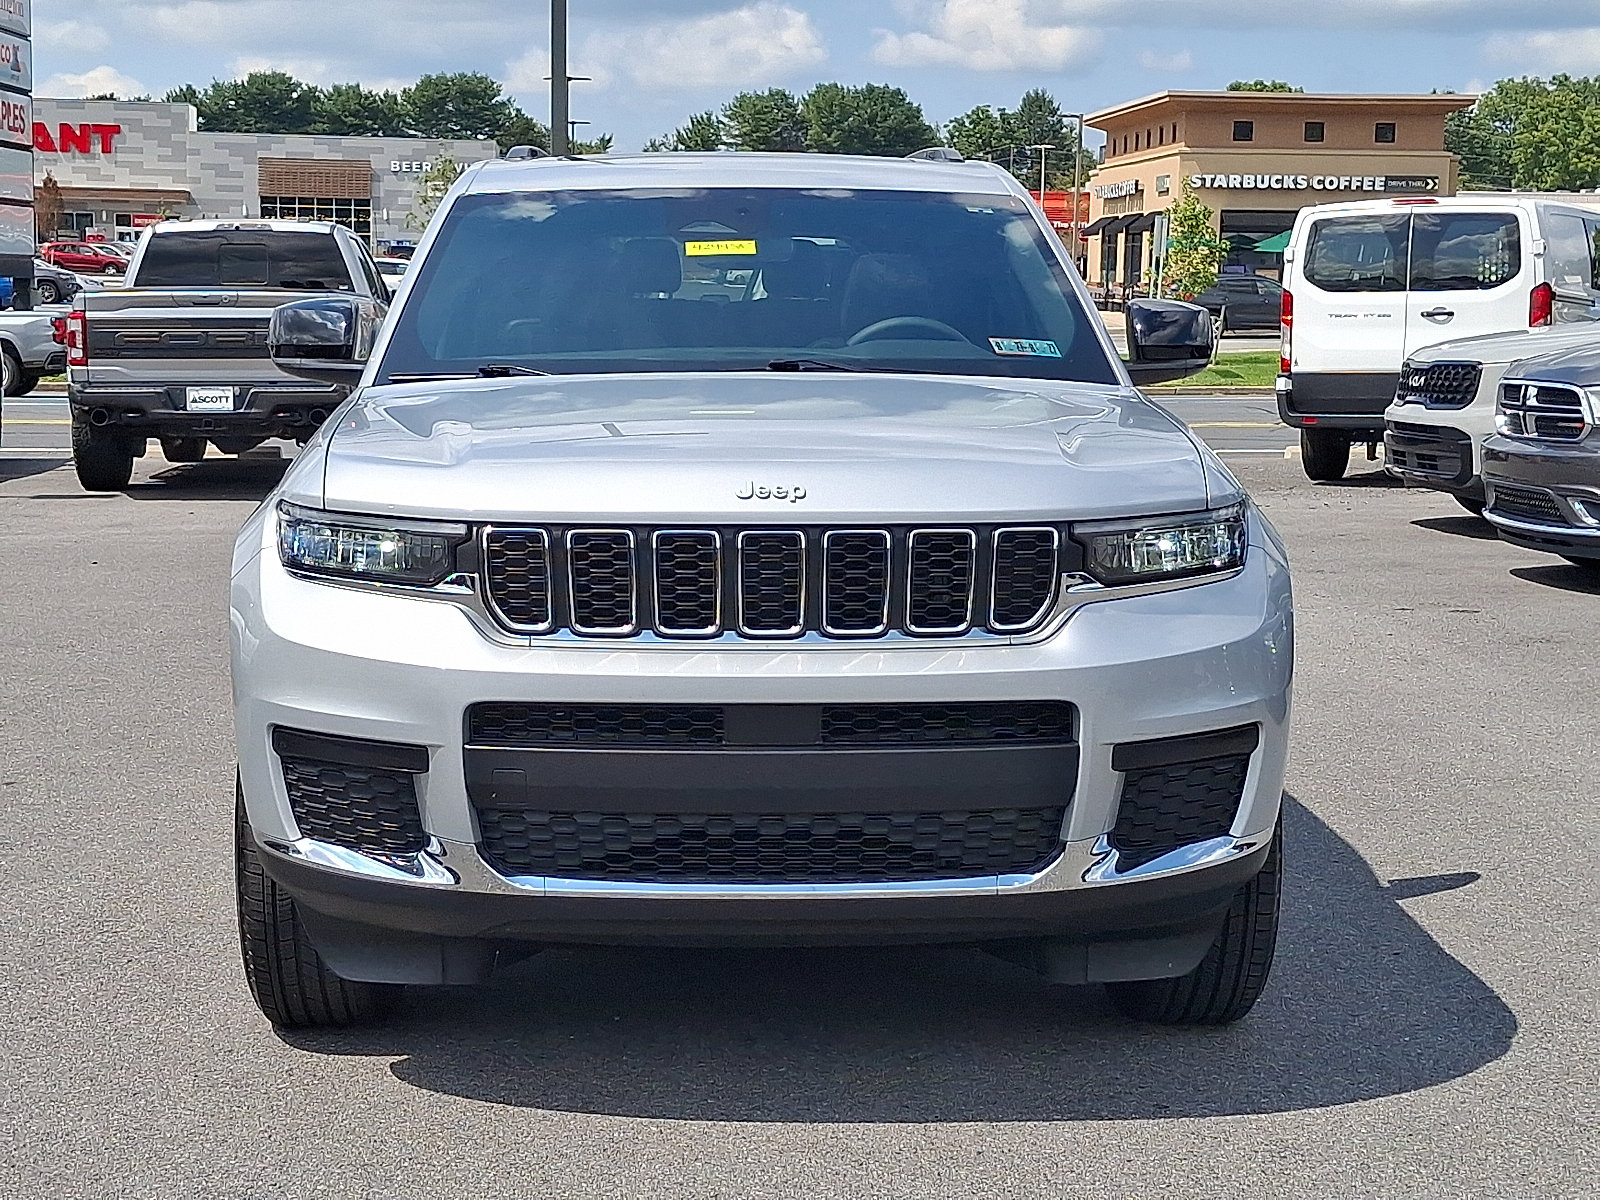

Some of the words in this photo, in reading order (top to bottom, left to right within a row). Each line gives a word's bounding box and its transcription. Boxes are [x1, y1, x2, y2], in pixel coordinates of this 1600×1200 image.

[390, 160, 432, 173] BEER
[1190, 174, 1308, 189] STARBUCKS
[1312, 175, 1386, 191] COFFEE
[735, 480, 807, 503] Jeep
